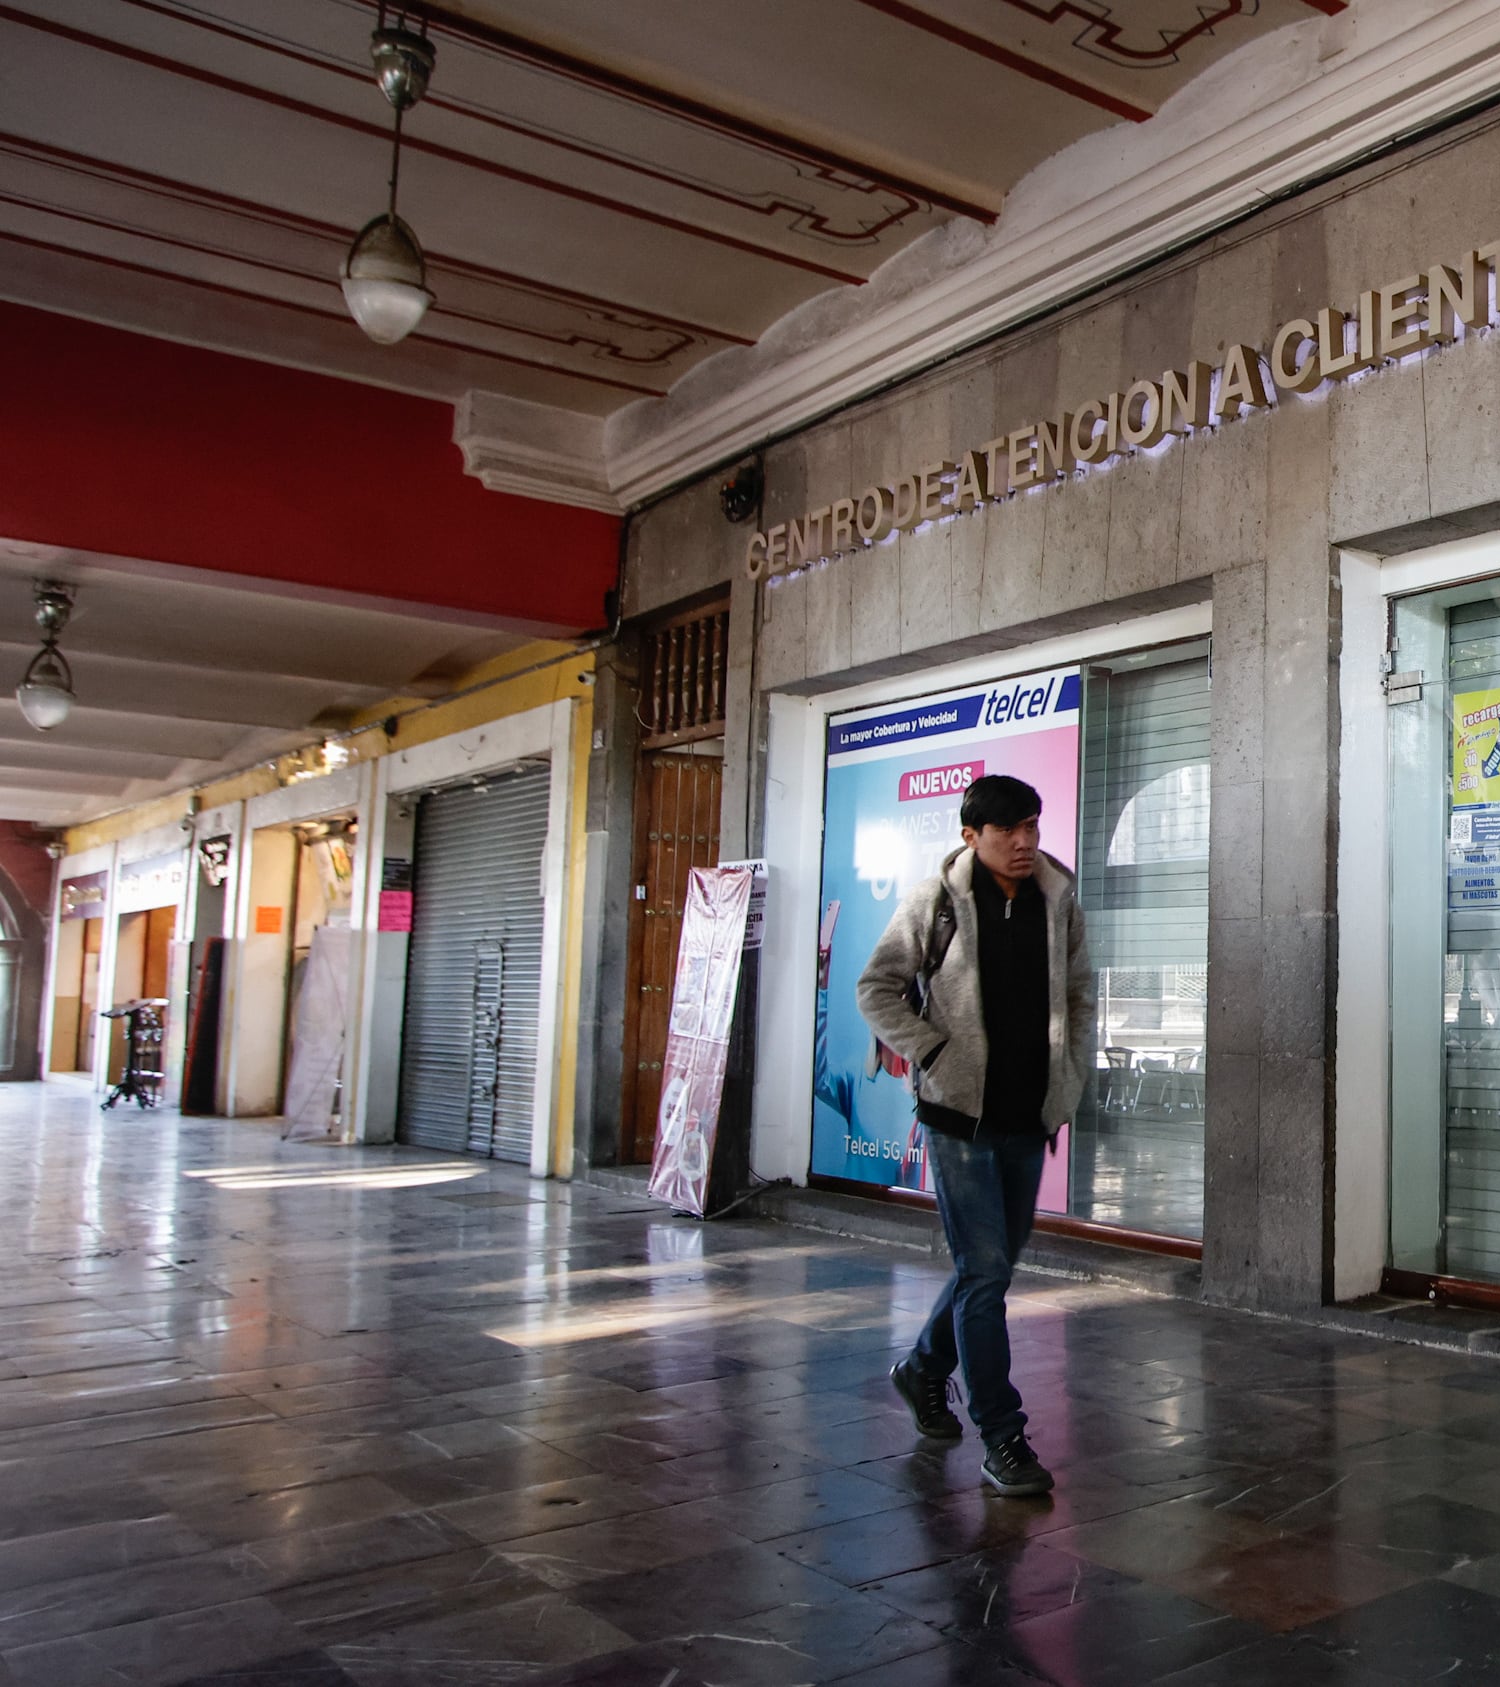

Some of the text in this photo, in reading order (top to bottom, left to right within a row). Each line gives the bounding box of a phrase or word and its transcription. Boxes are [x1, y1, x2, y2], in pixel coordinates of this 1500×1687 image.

[745, 486, 885, 581] CENTRO
[893, 461, 946, 528] DE
[953, 360, 1203, 510] ATENCION
[1215, 343, 1258, 415] A
[984, 677, 1056, 726] telcel
[840, 709, 958, 744] La mayor Cobertura y Velocidad
[908, 766, 973, 797] NUEVOS
[1458, 775, 1479, 791] $500
[1469, 890, 1498, 900] MASCOTAS
[844, 1134, 879, 1158] Telcel
[883, 1140, 904, 1165] 5G,
